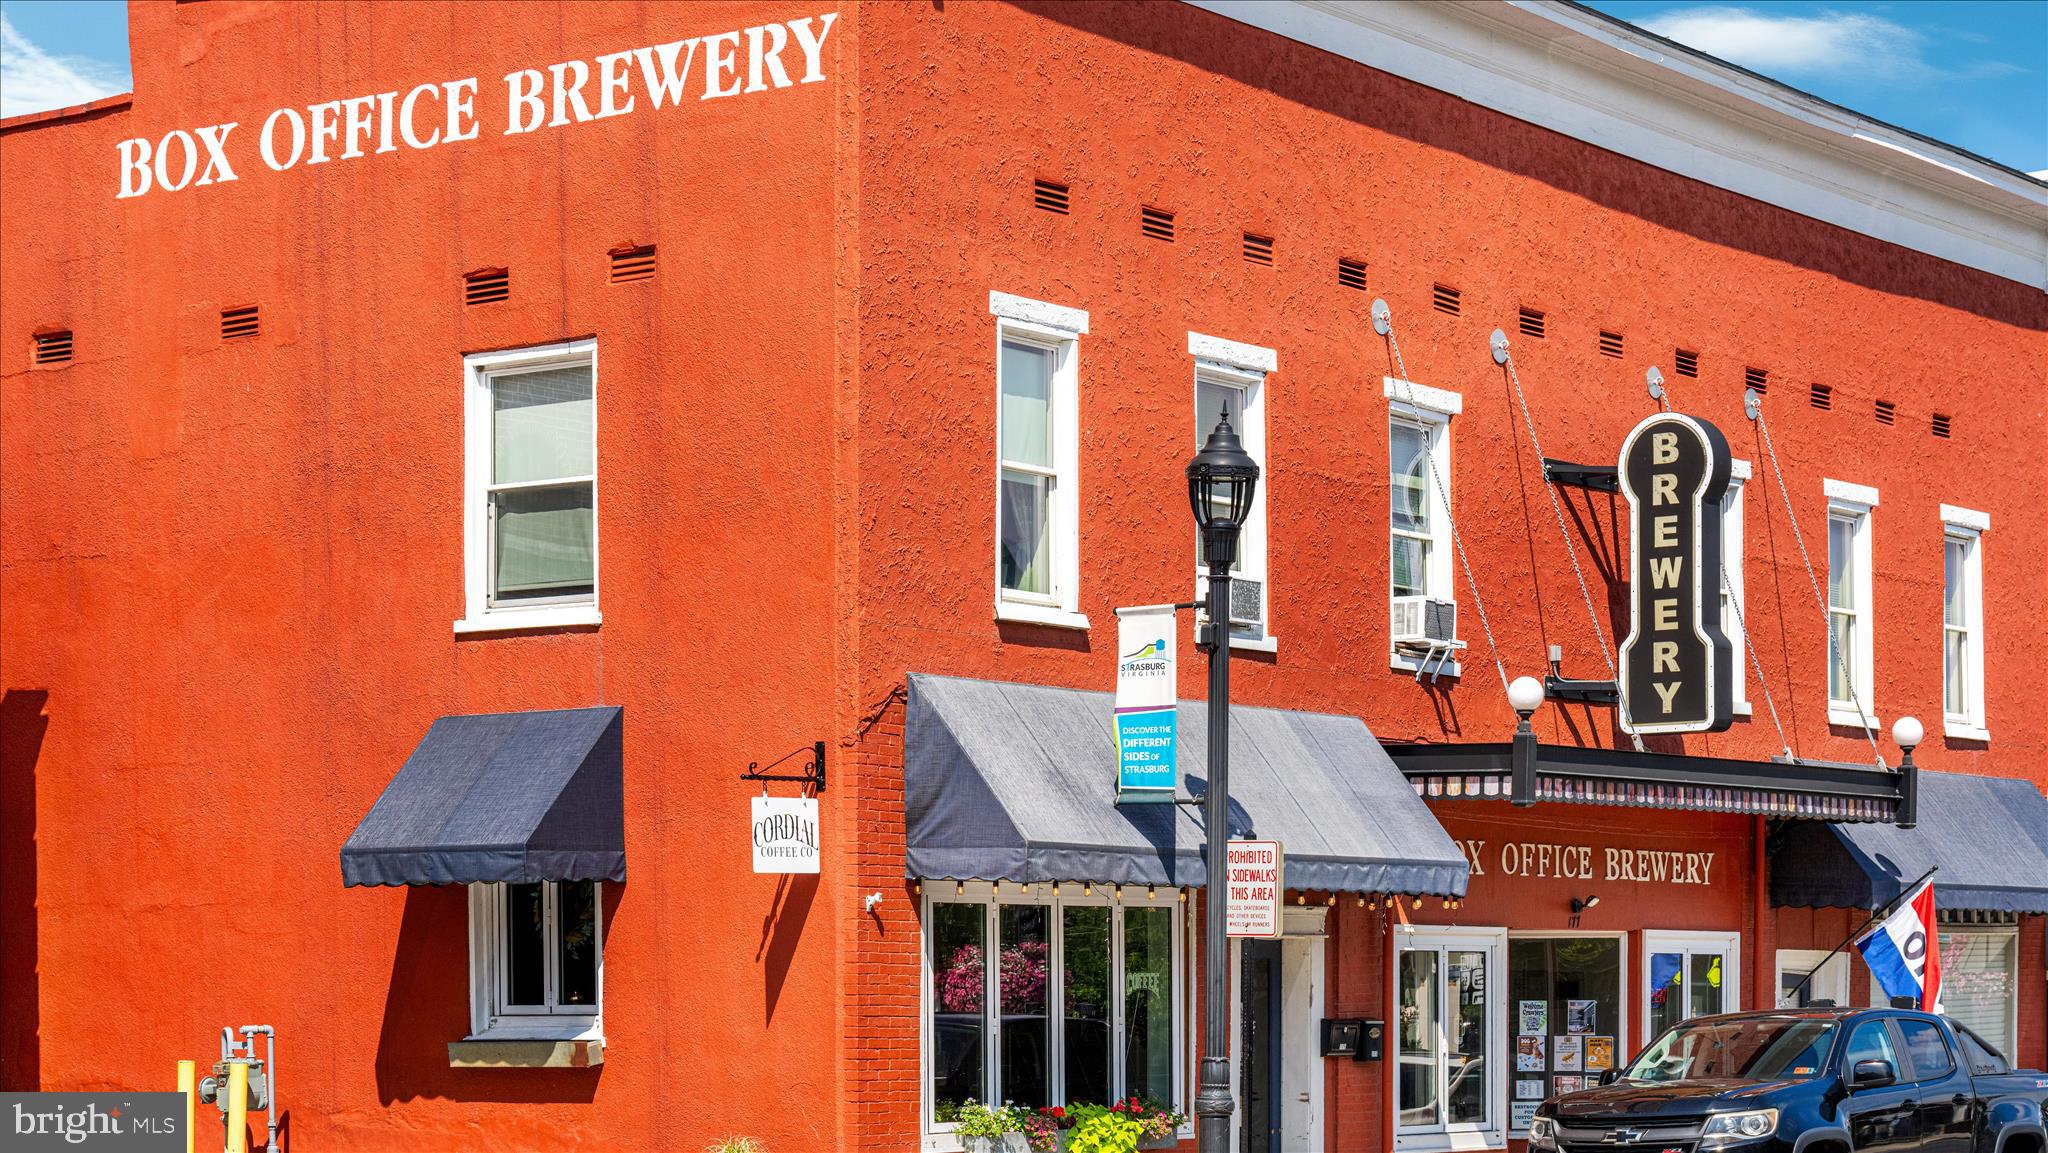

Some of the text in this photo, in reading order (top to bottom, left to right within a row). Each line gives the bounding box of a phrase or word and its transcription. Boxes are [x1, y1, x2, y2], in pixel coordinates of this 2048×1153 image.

[116, 13, 839, 199] BOX OFFICE BREWERY
[1650, 432, 1683, 714] BREWERY
[1121, 662, 1166, 672] STRASBURG
[1121, 670, 1166, 678] VIRGINIA
[1122, 725, 1172, 735] DISCOVER THE
[1123, 737, 1172, 748] DIFFERENT
[1123, 752, 1150, 761] SIDES
[1124, 764, 1170, 774] STRASBURG
[754, 813, 819, 851] CORDIAL
[760, 846, 813, 858] COFFEE CO
[1228, 850, 1273, 864] ROHIBITED
[1501, 842, 1593, 879] OFFICE
[1604, 848, 1715, 886] BREWERY
[1232, 868, 1277, 882] SIDEWALKS
[1231, 887, 1274, 901] THIS AREA
